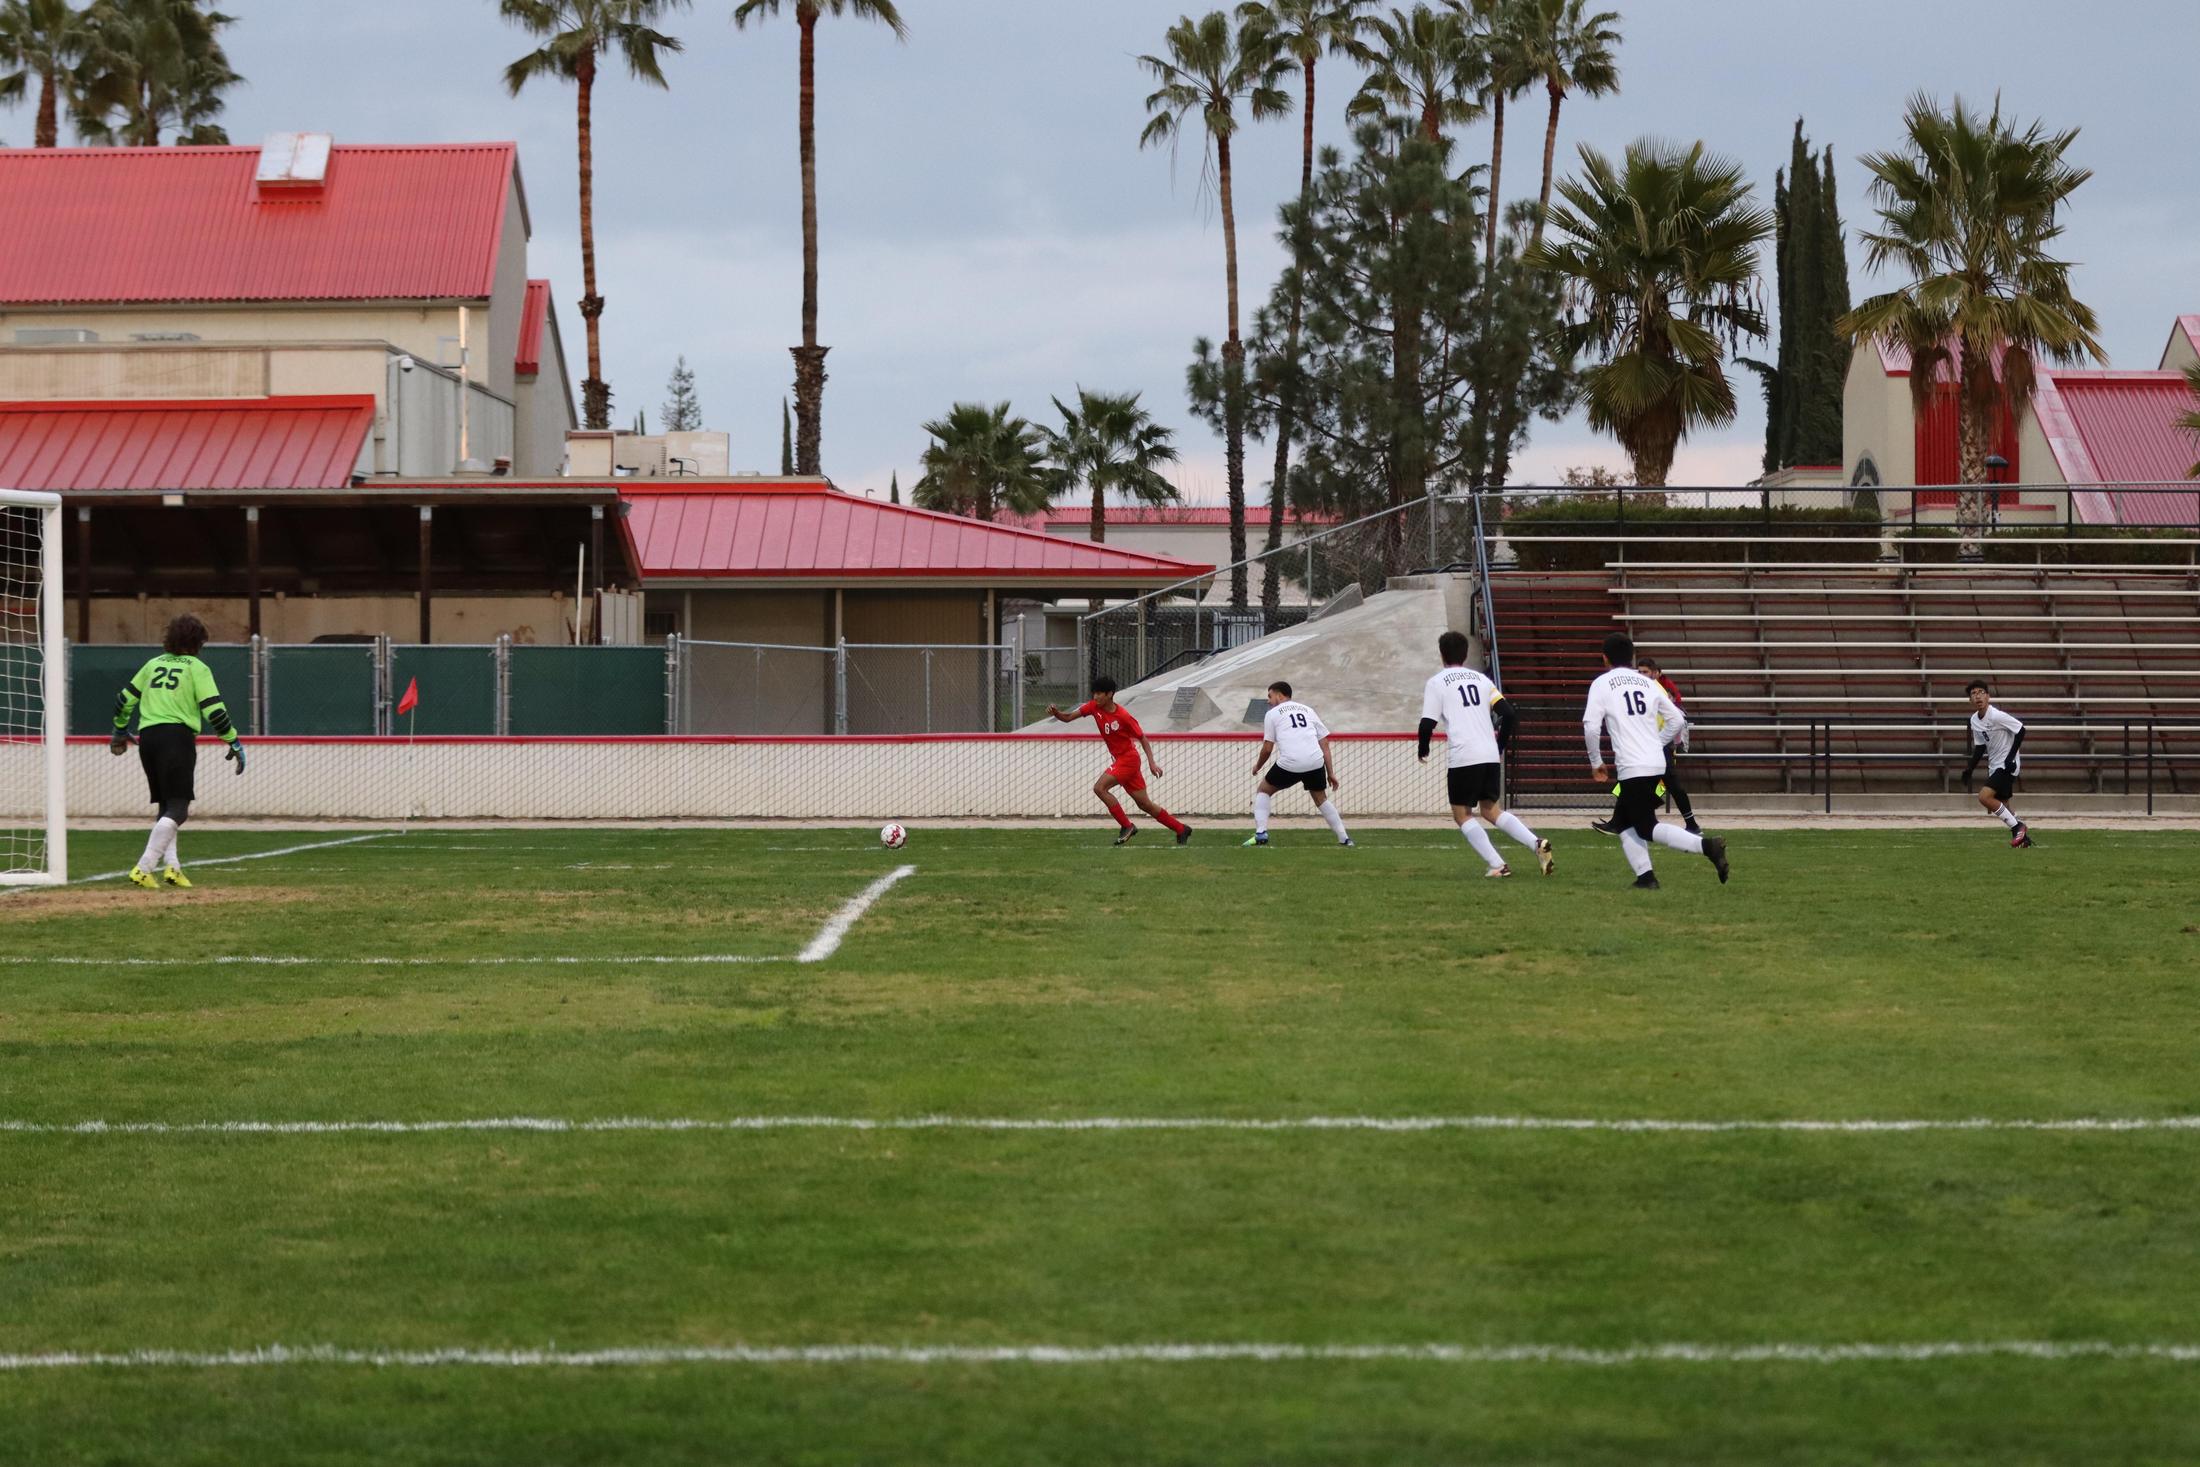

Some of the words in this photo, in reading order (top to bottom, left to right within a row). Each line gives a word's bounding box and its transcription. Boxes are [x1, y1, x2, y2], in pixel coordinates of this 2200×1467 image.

[150, 666, 183, 690] 25
[1443, 671, 1481, 686] HUGHSON
[1608, 675, 1650, 690] HUGHSON
[1458, 684, 1480, 707] 10
[1623, 690, 1647, 715] 16
[1289, 713, 1307, 728] 19
